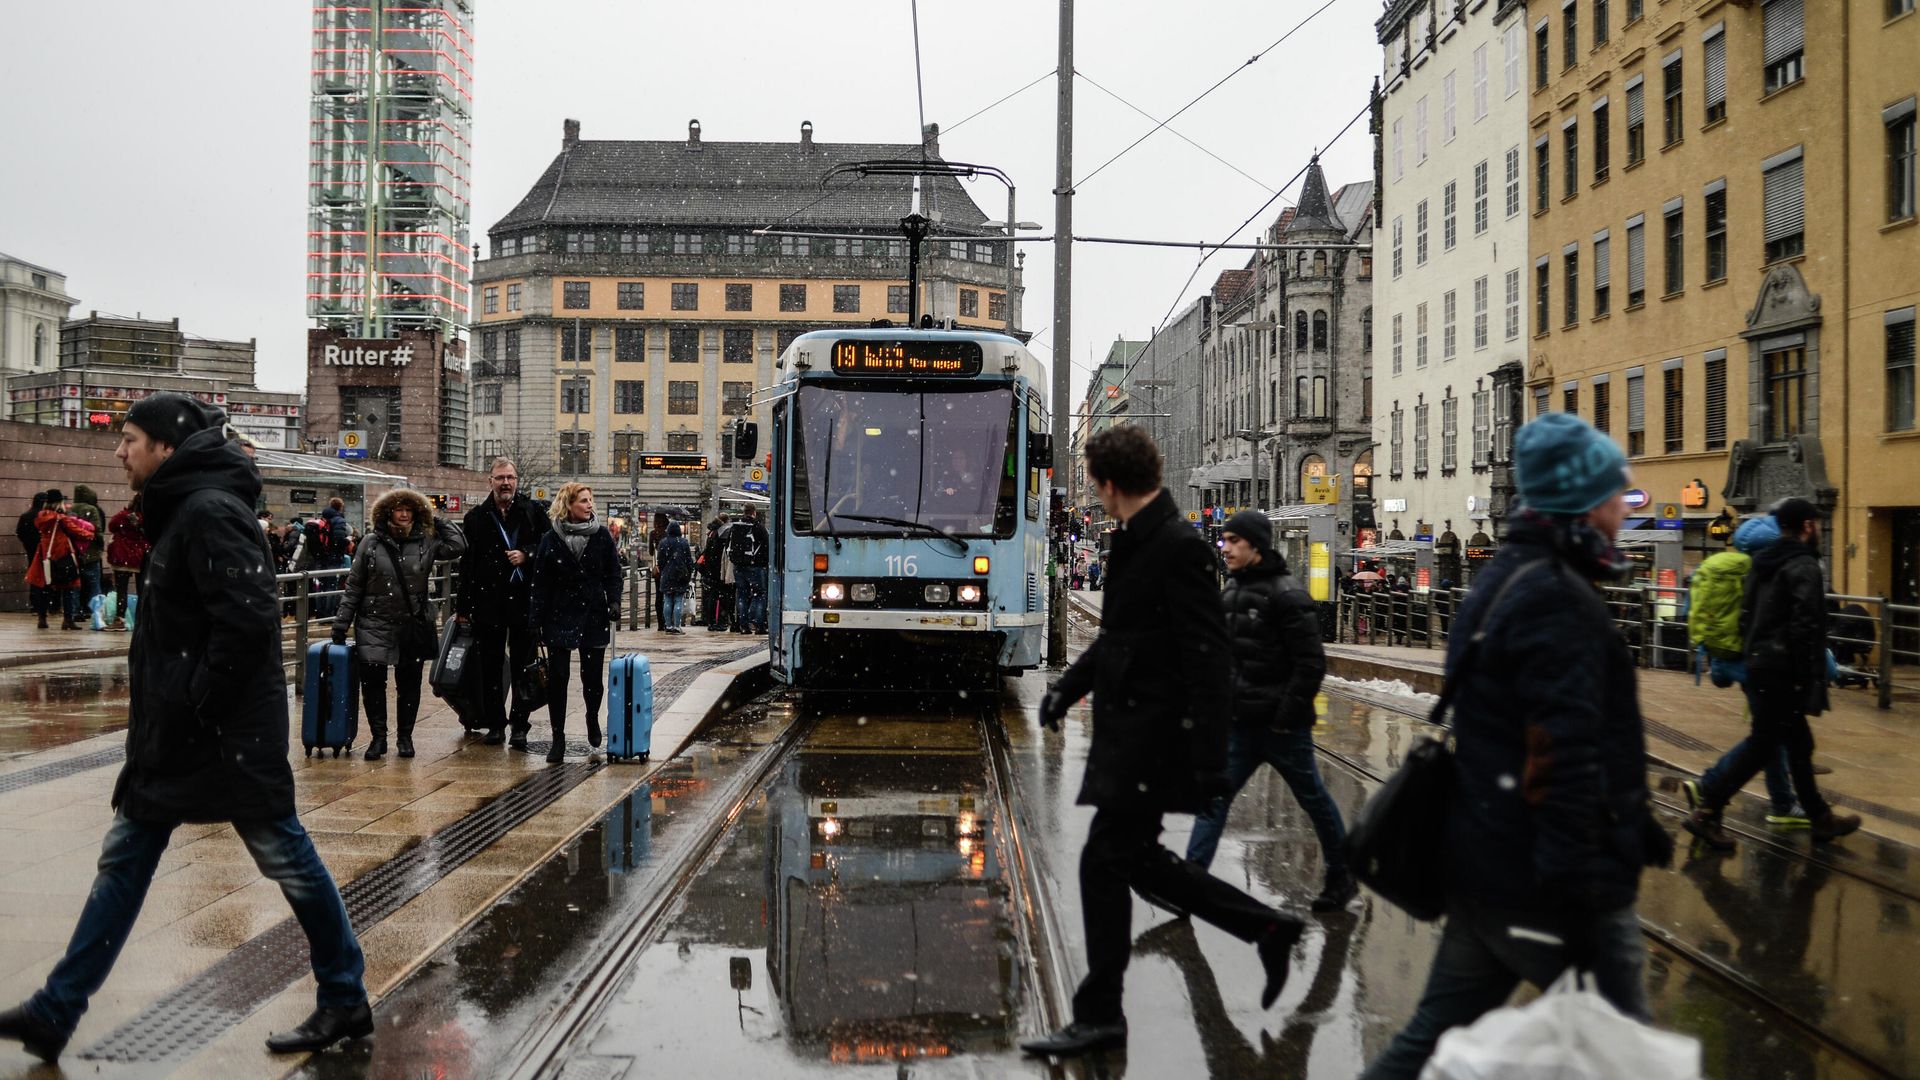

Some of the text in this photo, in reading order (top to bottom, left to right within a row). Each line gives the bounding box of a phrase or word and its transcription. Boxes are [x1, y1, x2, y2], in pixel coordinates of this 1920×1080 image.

[238, 416, 281, 425] TAKE AWAY
[884, 555, 918, 577] 116
